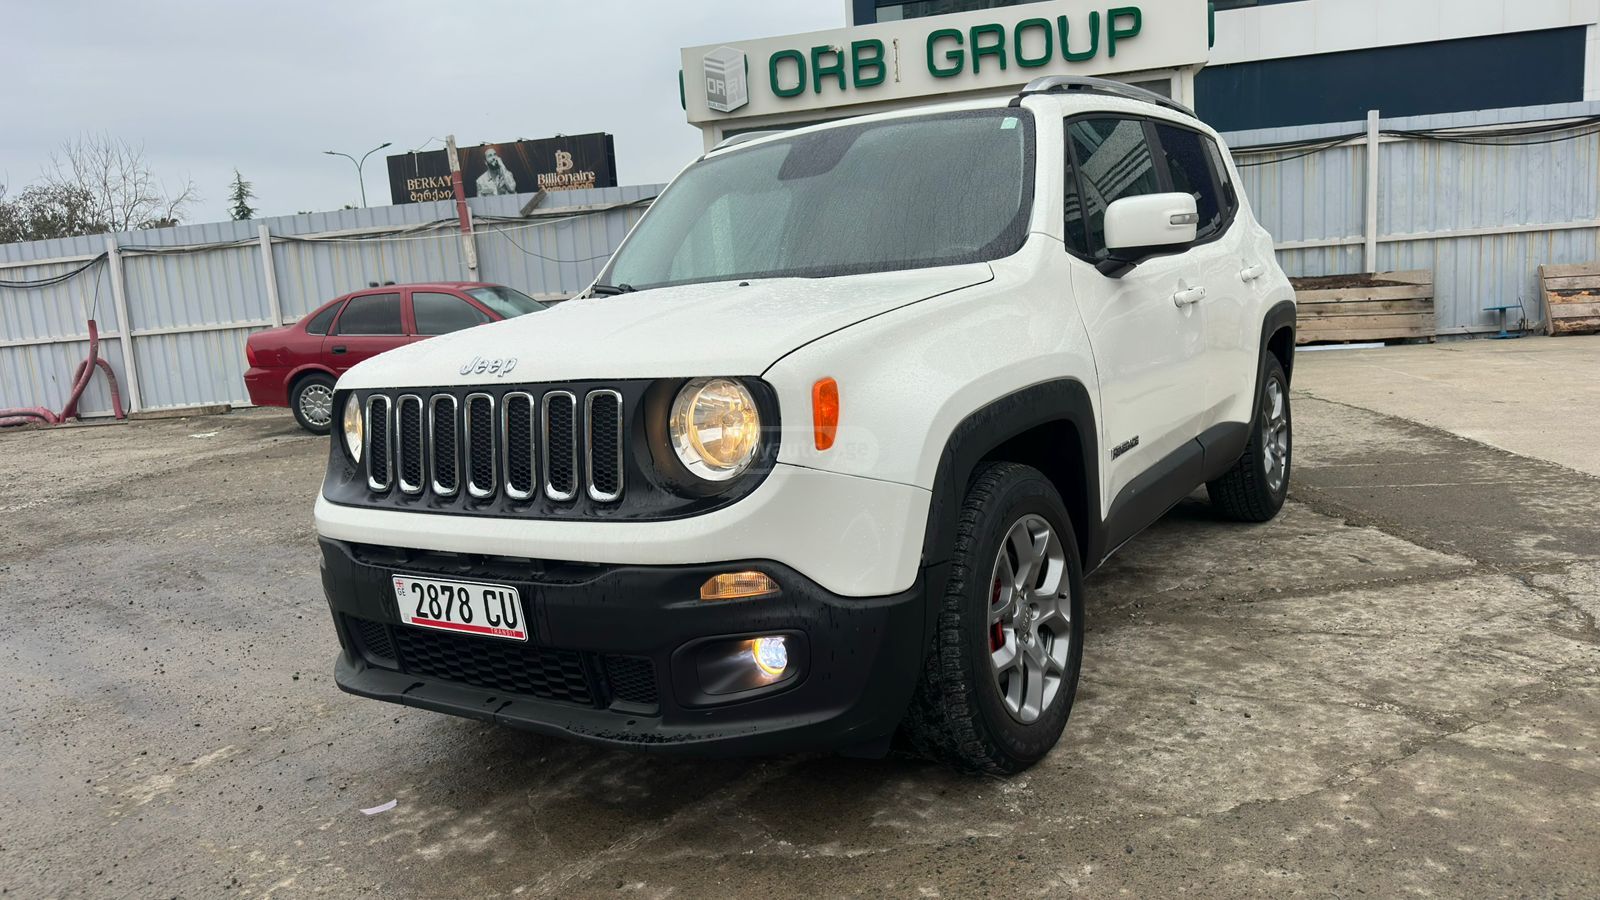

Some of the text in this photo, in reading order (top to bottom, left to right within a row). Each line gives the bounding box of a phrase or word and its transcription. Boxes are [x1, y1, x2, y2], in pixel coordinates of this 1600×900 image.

[926, 6, 1142, 78] GROUP
[407, 175, 452, 191] BERKAY
[537, 170, 596, 185] Billionaire
[459, 353, 518, 378] Jeep
[411, 582, 518, 629] 2878 CU
[490, 627, 517, 637] TRANSIT
